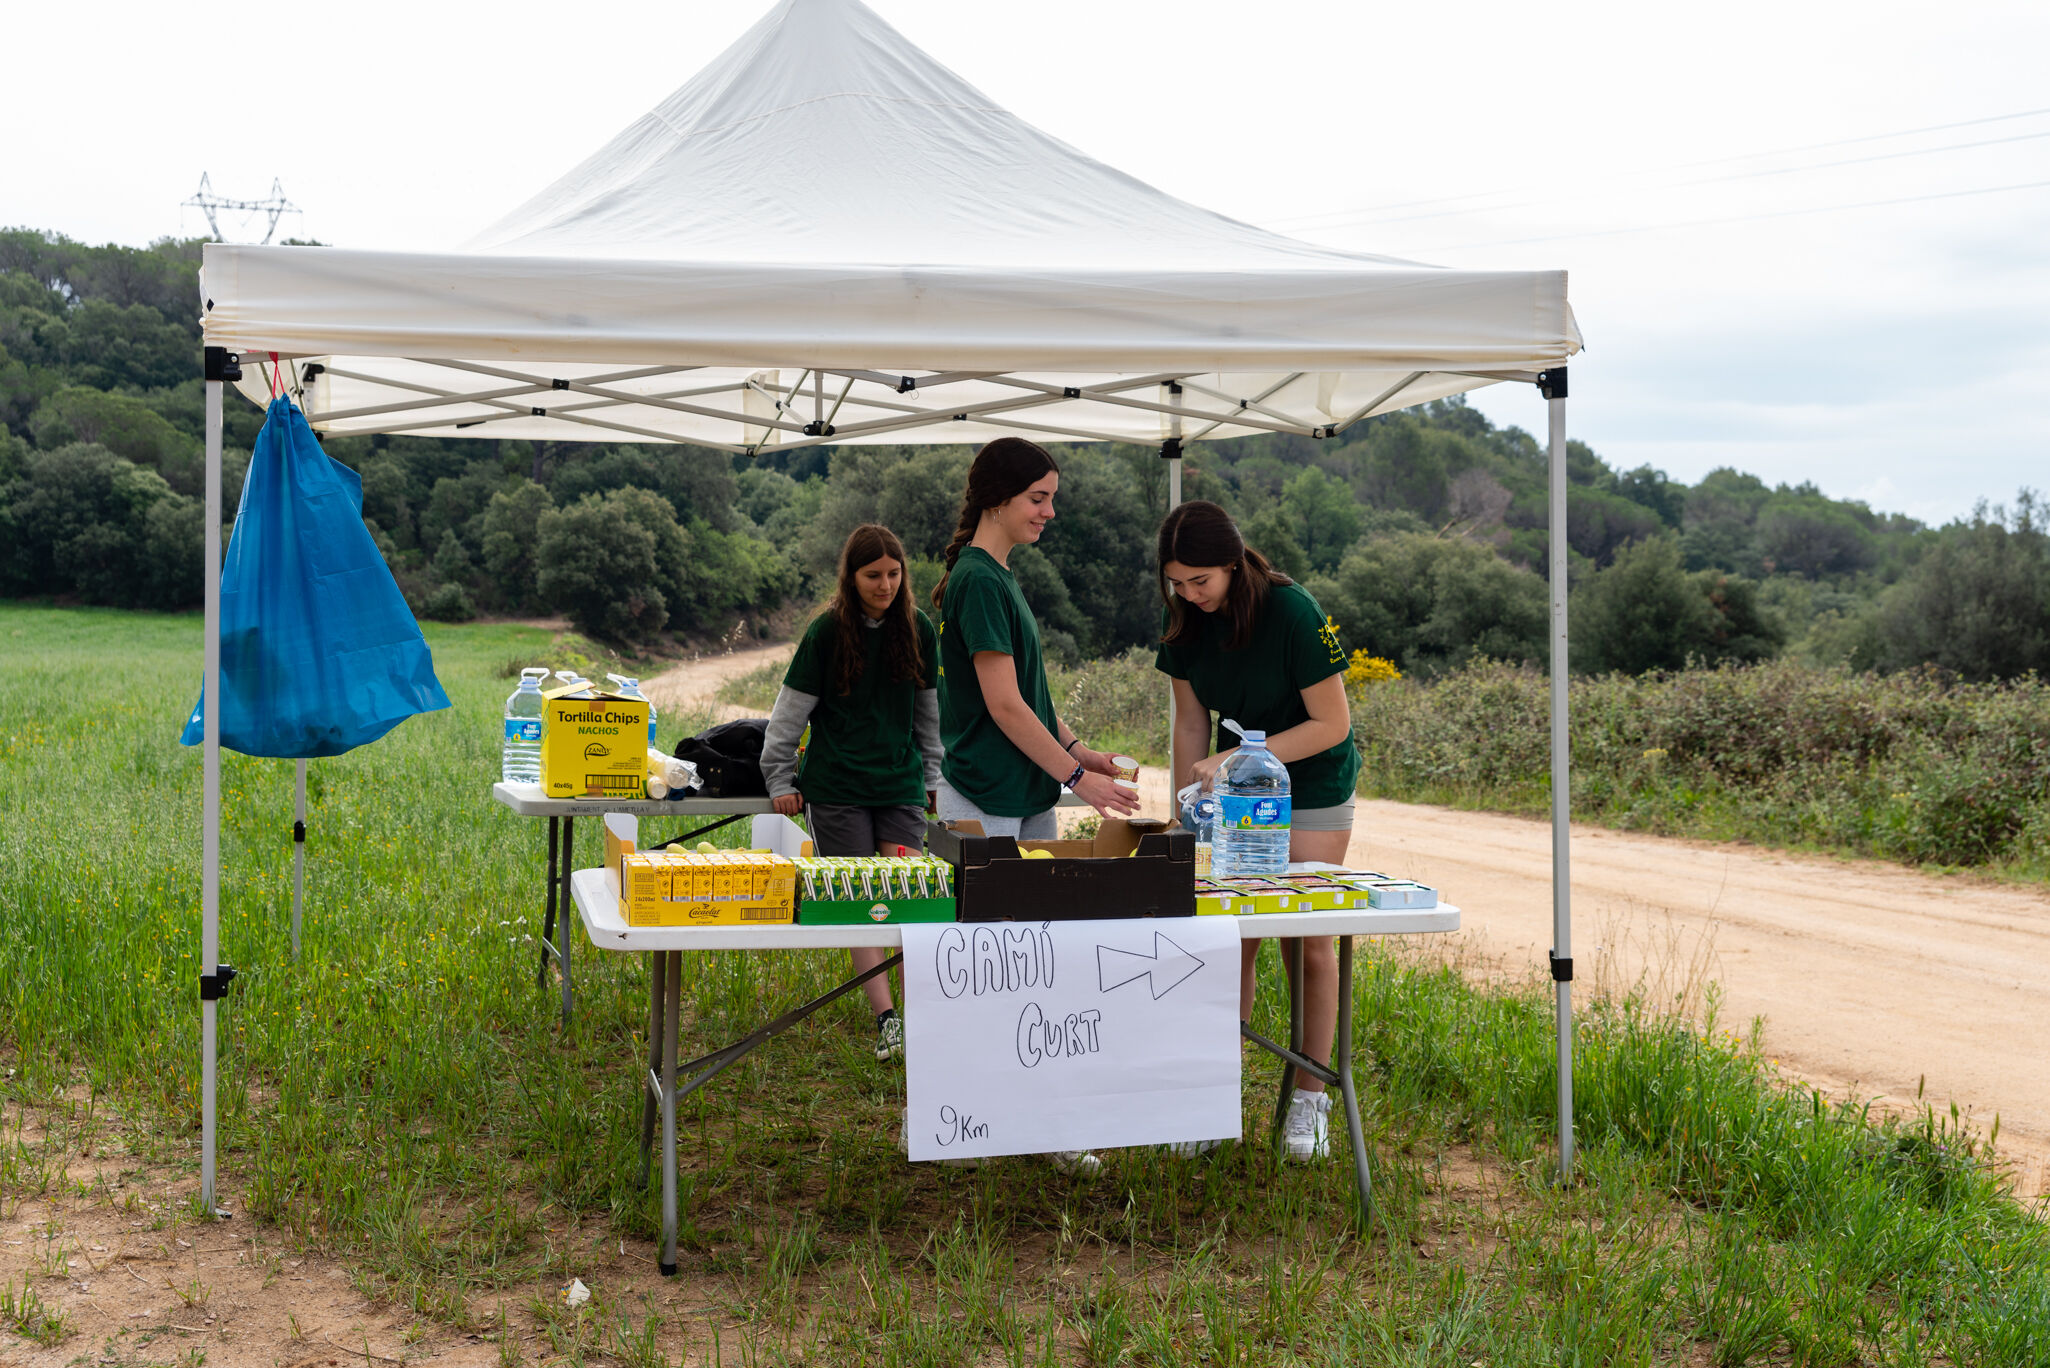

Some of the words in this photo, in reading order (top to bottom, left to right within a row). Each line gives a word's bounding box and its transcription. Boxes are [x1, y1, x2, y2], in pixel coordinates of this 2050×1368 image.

[557, 711, 602, 722] Tortilla
[605, 712, 640, 725] Chips
[578, 726, 619, 735] NACHOS
[1260, 801, 1273, 809] Font
[1255, 808, 1278, 816] Agudes
[689, 906, 721, 919] Cacaolat
[936, 921, 1054, 999] CAMÍ
[1016, 1002, 1101, 1068] CURT
